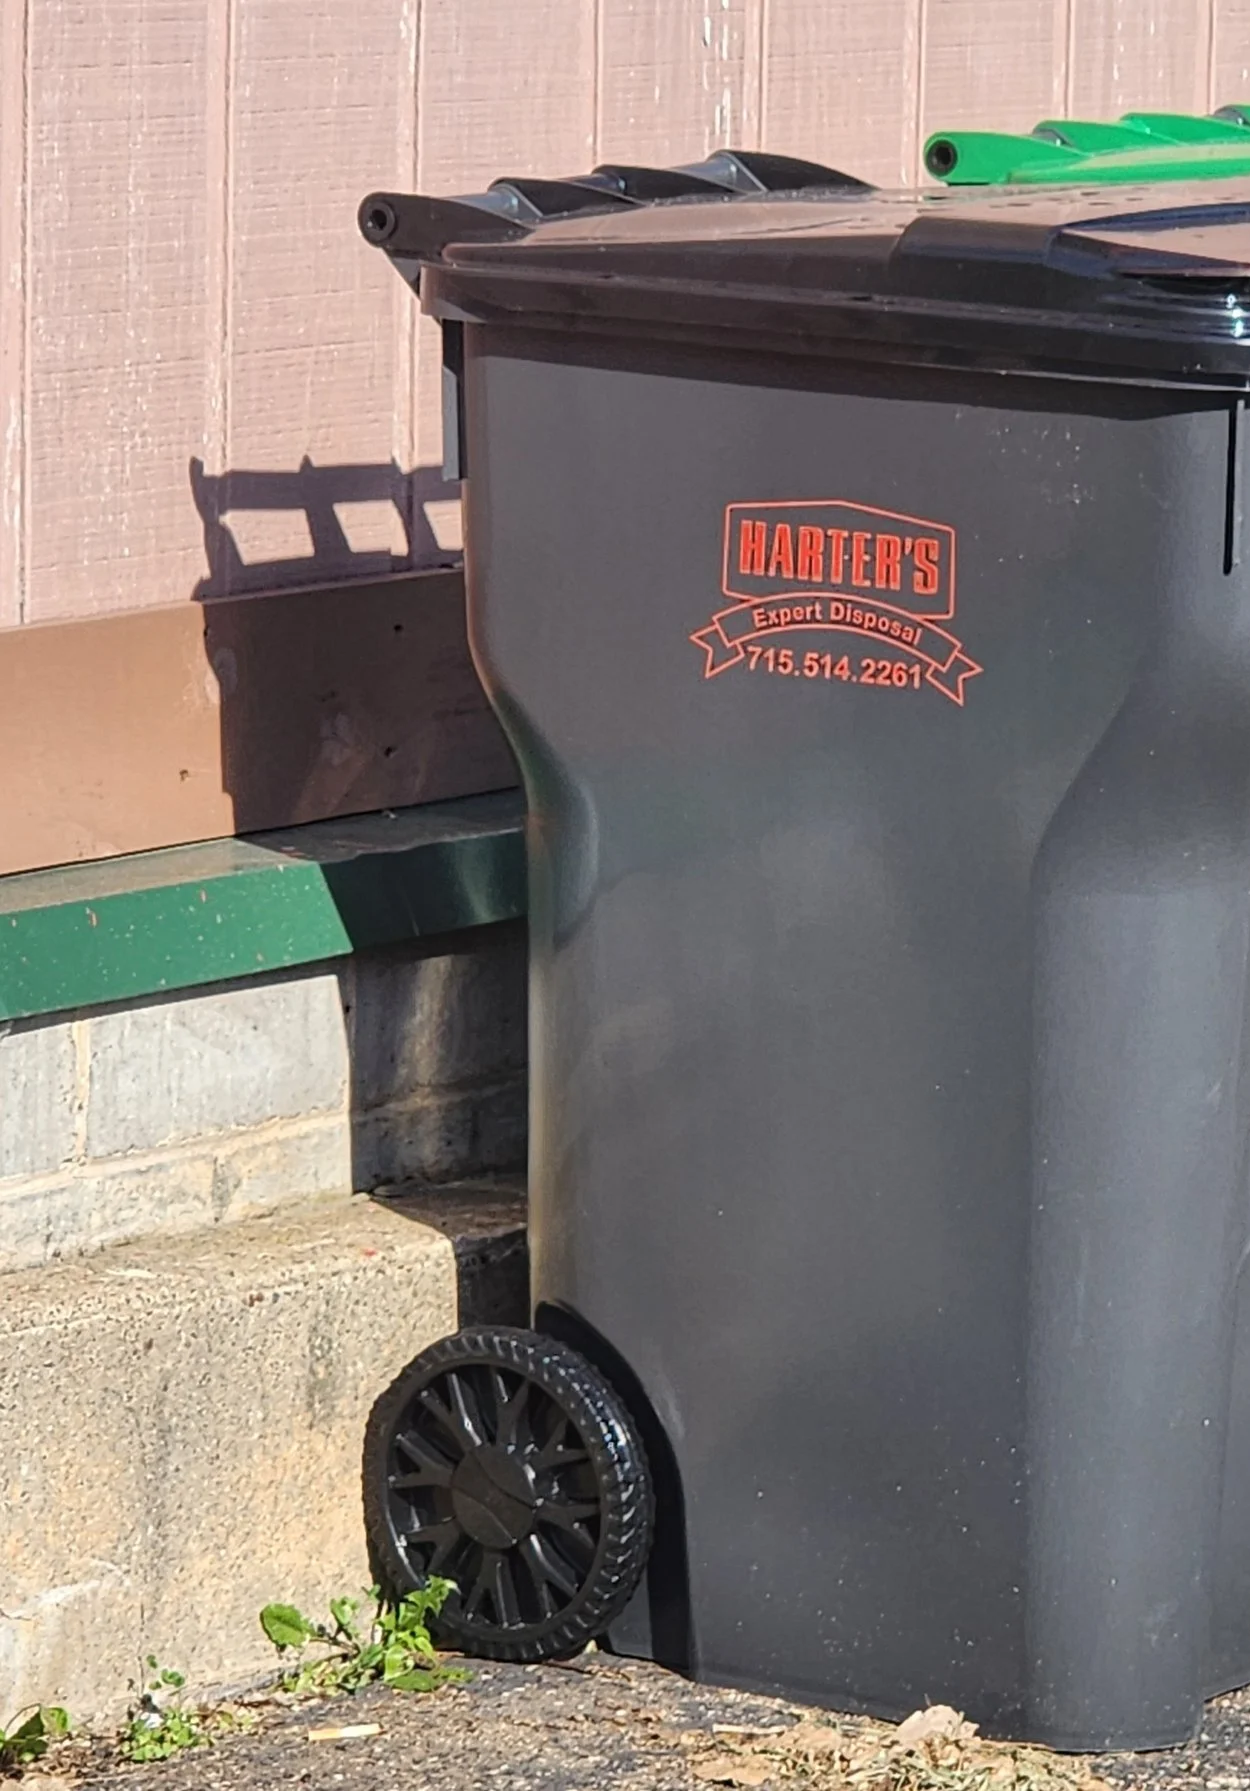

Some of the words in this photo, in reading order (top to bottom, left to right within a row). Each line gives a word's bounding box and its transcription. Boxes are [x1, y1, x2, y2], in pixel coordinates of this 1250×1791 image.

[738, 519, 940, 594] HARTER'S
[752, 602, 823, 629] Expert
[829, 602, 923, 646] Disposal
[746, 646, 922, 689] 715.514.2261
